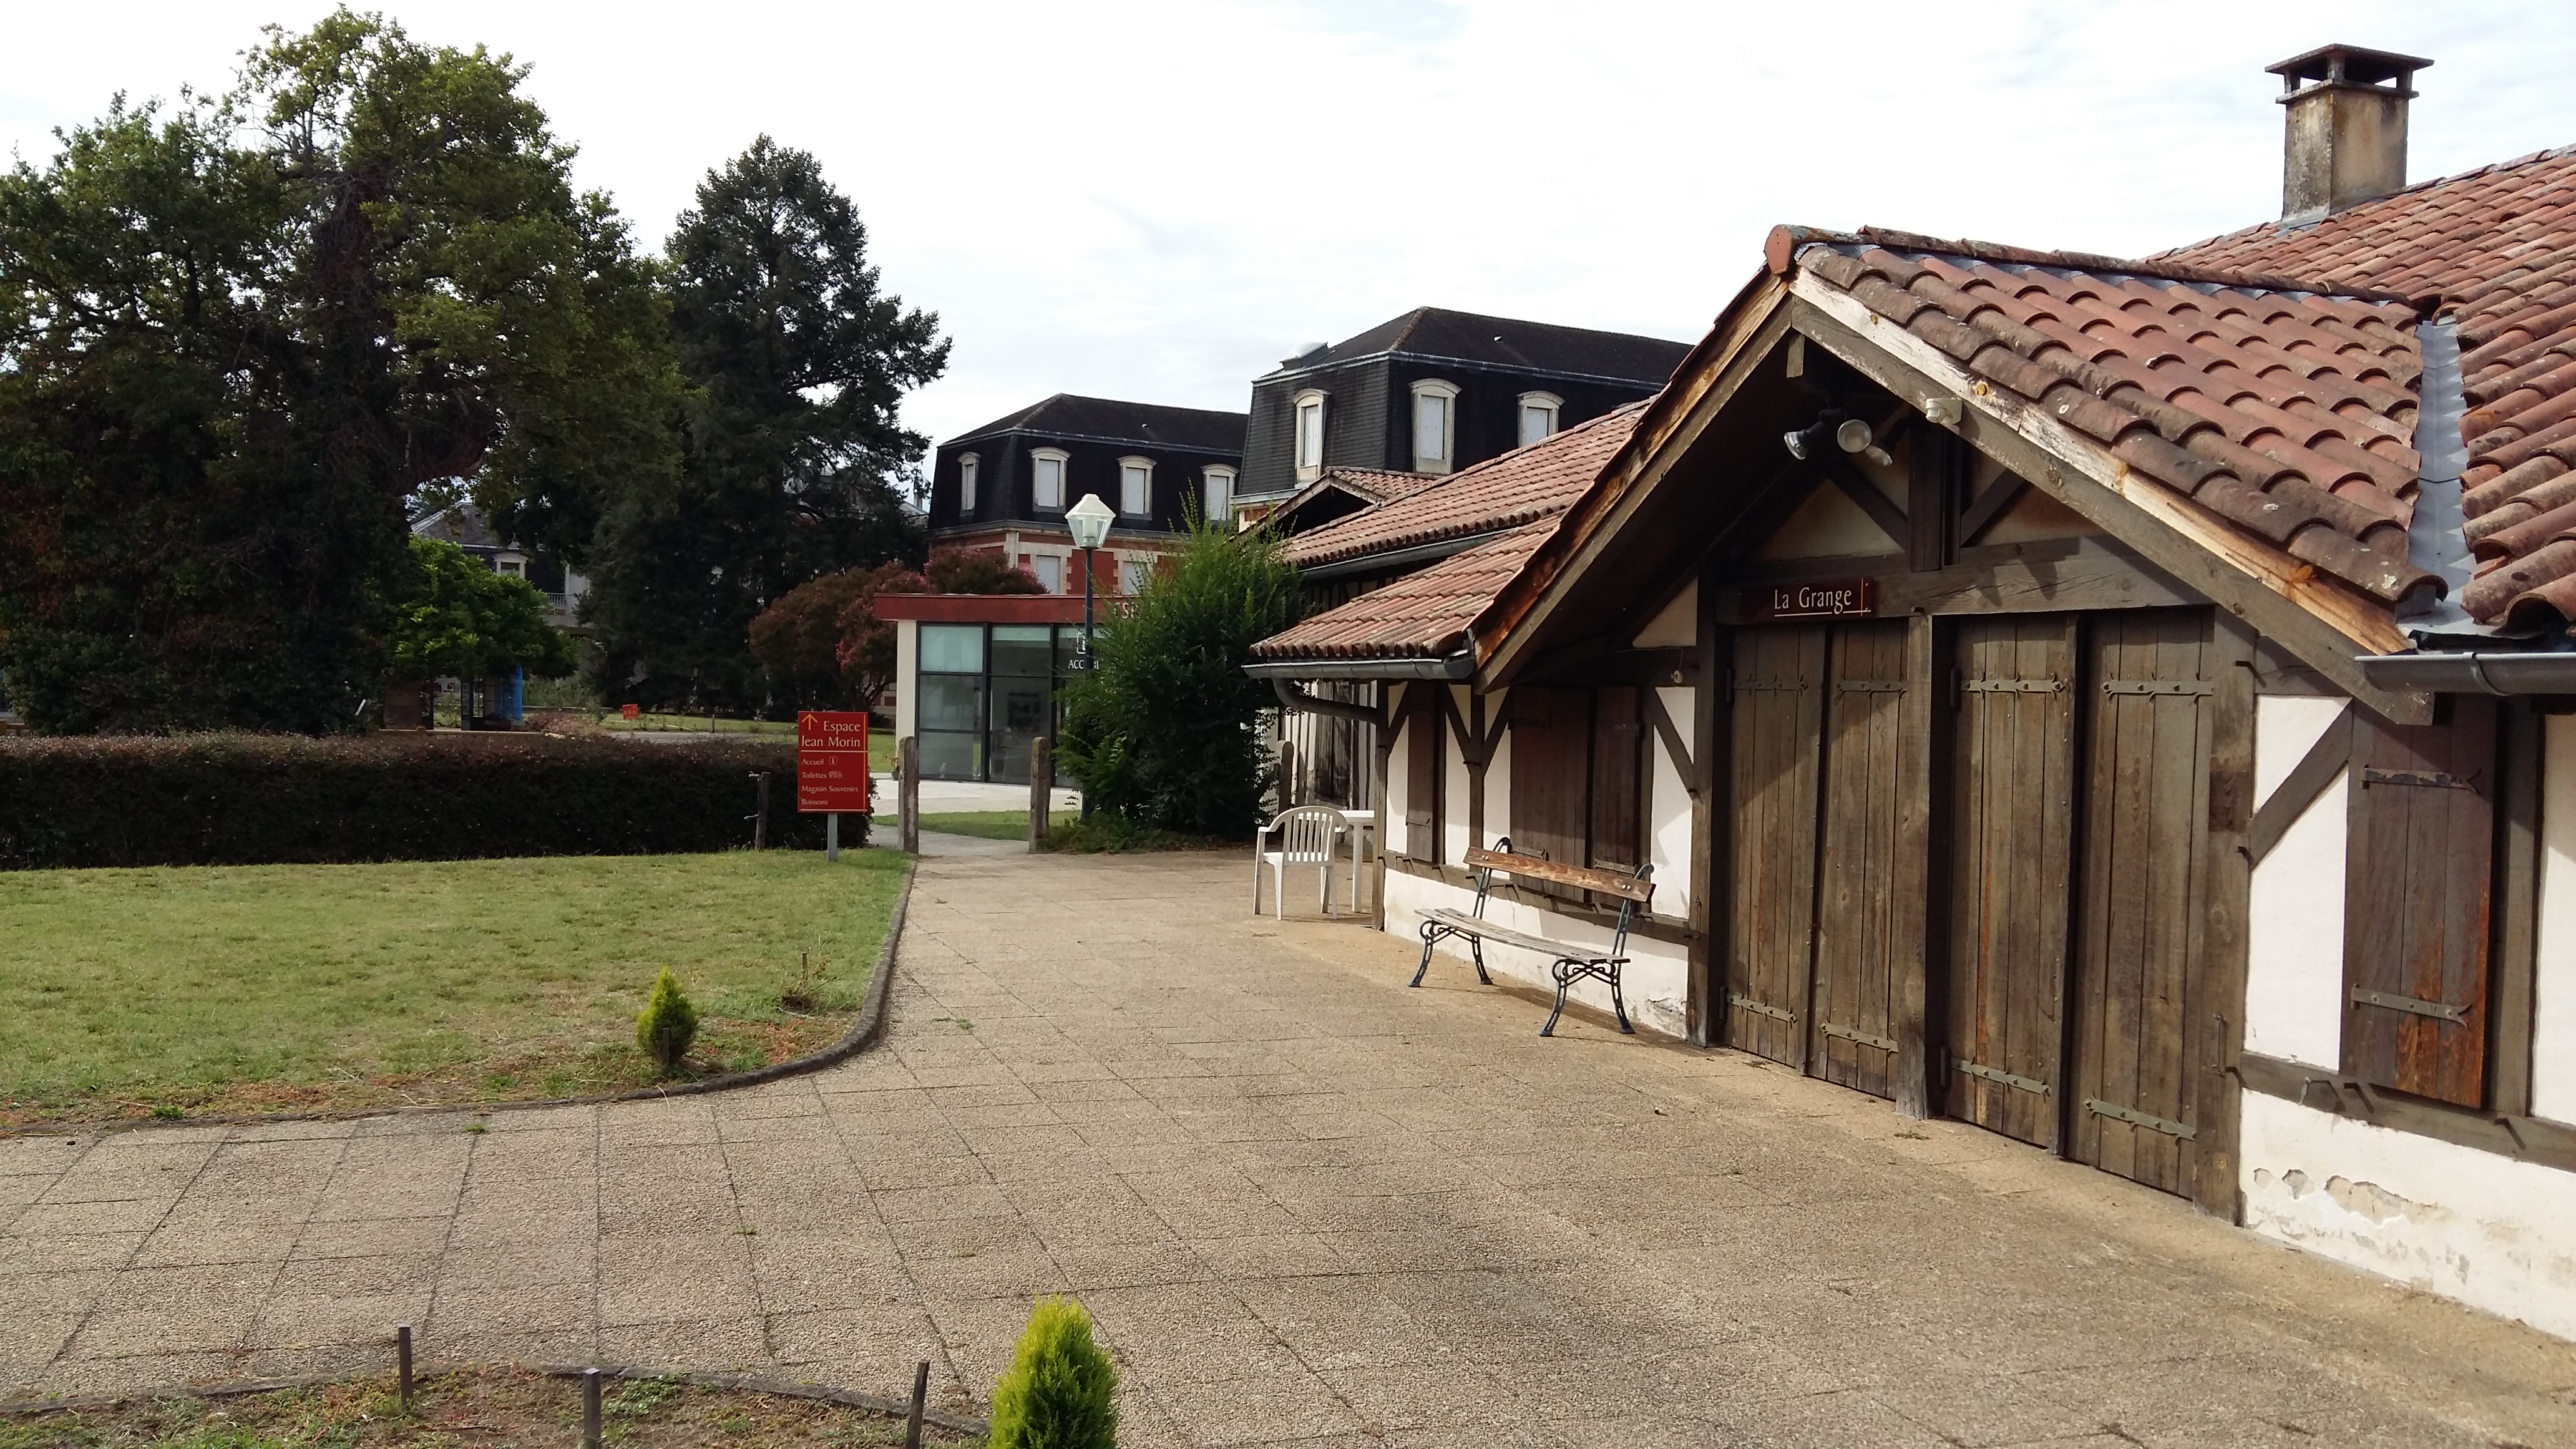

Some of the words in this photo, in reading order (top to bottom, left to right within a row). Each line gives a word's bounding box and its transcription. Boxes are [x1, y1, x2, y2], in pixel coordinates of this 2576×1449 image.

[1774, 589, 1789, 610] La
[1798, 587, 1852, 615] Grange
[1068, 660, 1099, 670] ACCIL
[824, 721, 861, 735] Espace
[801, 735, 824, 747] Jean
[828, 736, 861, 747] Morin
[801, 786, 827, 794] Magasin
